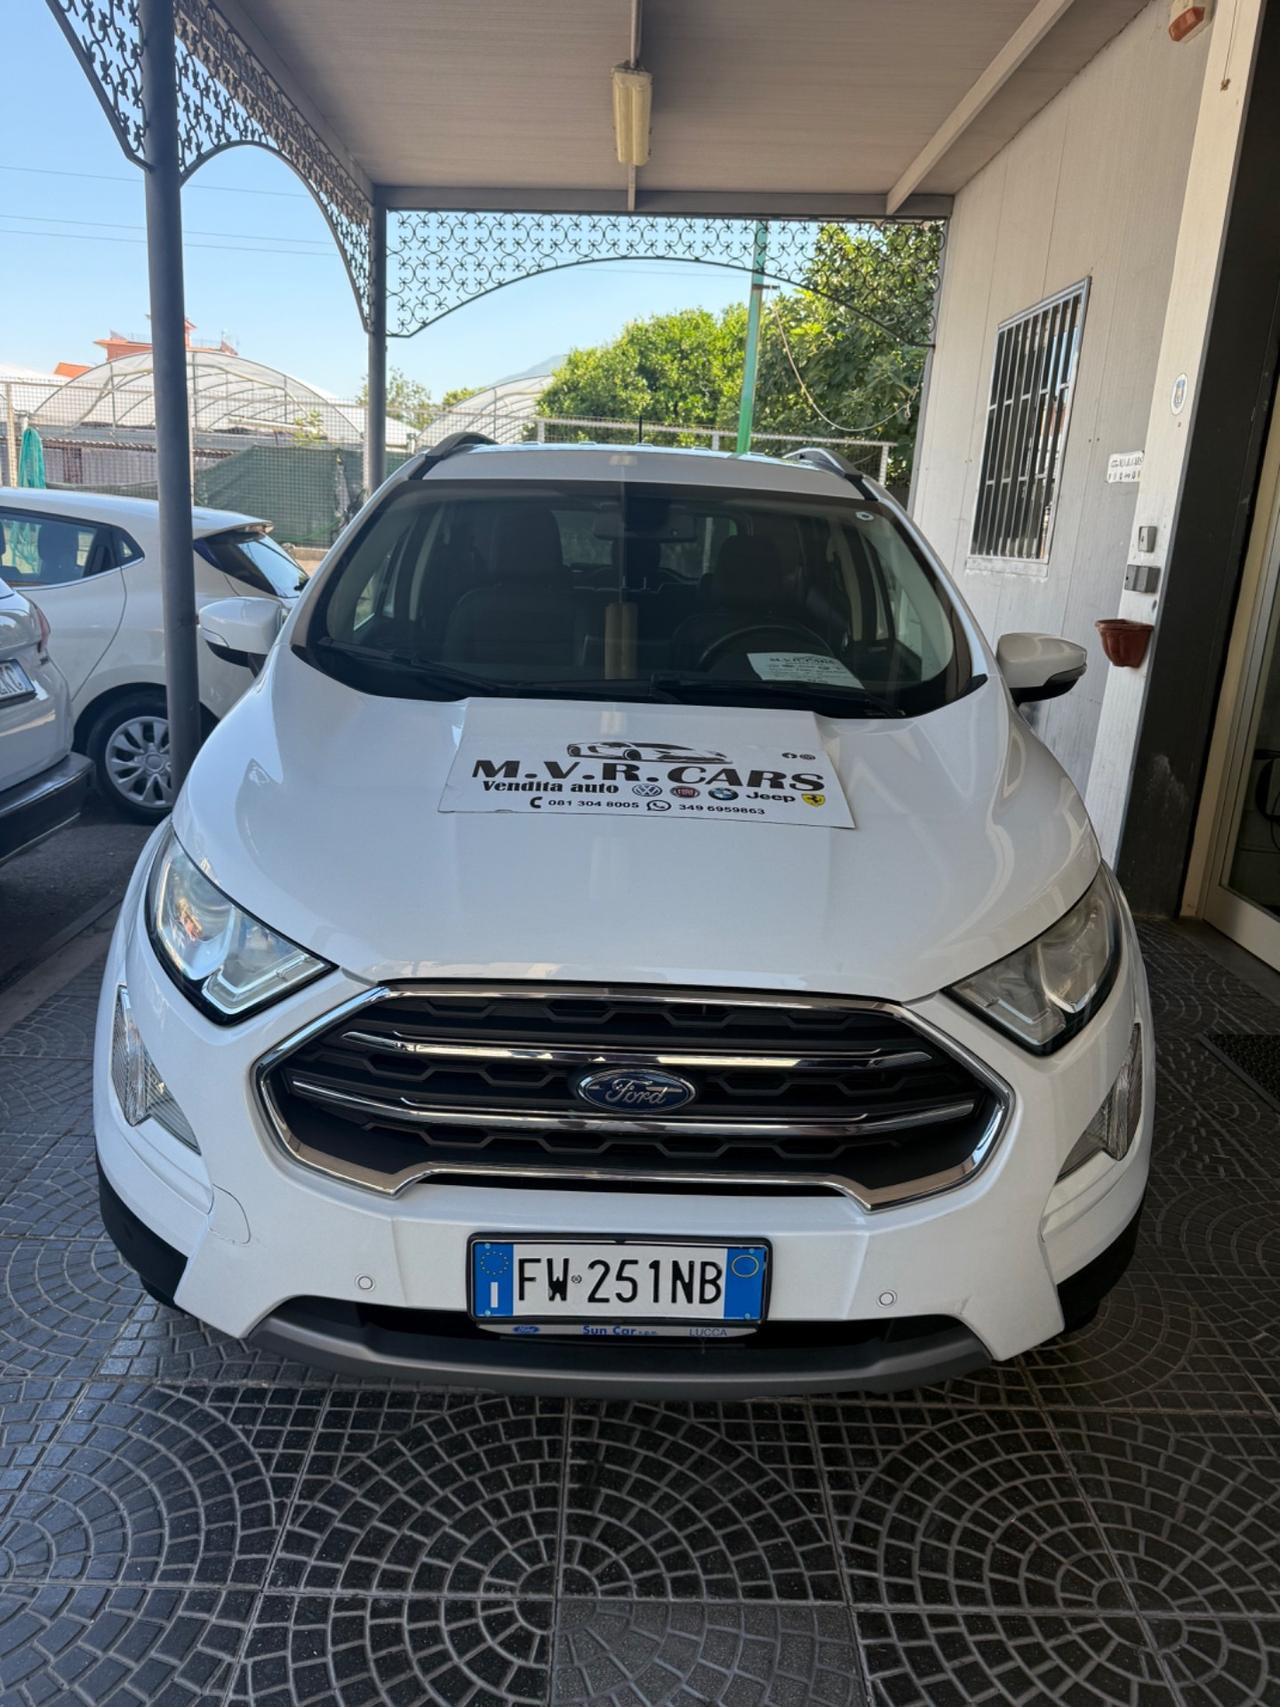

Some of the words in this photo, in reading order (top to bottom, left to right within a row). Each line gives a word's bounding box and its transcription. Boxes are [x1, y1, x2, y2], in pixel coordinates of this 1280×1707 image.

[483, 780, 563, 793] Vendita
[570, 782, 619, 794] auto
[746, 791, 796, 804] Jeep
[548, 799, 572, 807] 081
[578, 800, 601, 808] 304
[606, 801, 639, 809] 8005
[679, 803, 704, 811] 349
[605, 1078, 668, 1104] Ford
[582, 1325, 608, 1336] Sun
[612, 1326, 636, 1336] Car
[688, 1327, 728, 1337] LUCCA
